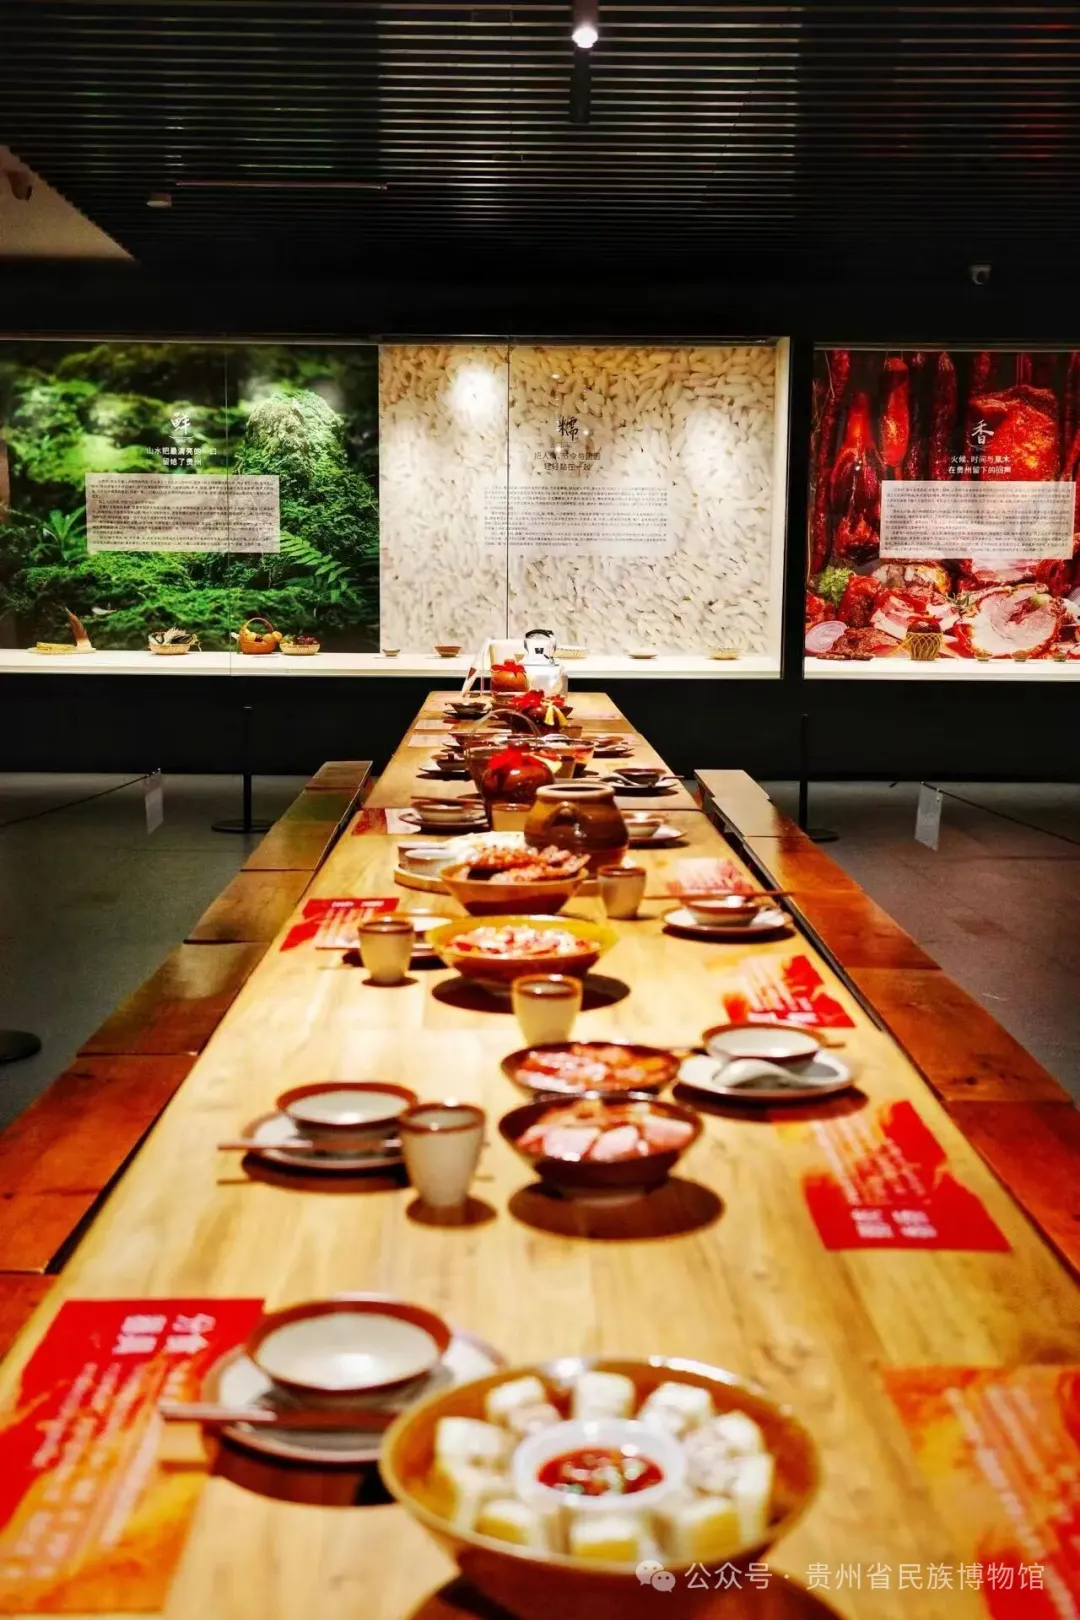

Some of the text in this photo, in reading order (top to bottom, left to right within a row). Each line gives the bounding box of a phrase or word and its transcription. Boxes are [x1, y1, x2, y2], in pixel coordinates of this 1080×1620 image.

[558, 416, 579, 441] 糯
[971, 419, 995, 445] 香
[146, 446, 217, 456] 山水把最清亮的口
[162, 457, 202, 466] 留给了贵州
